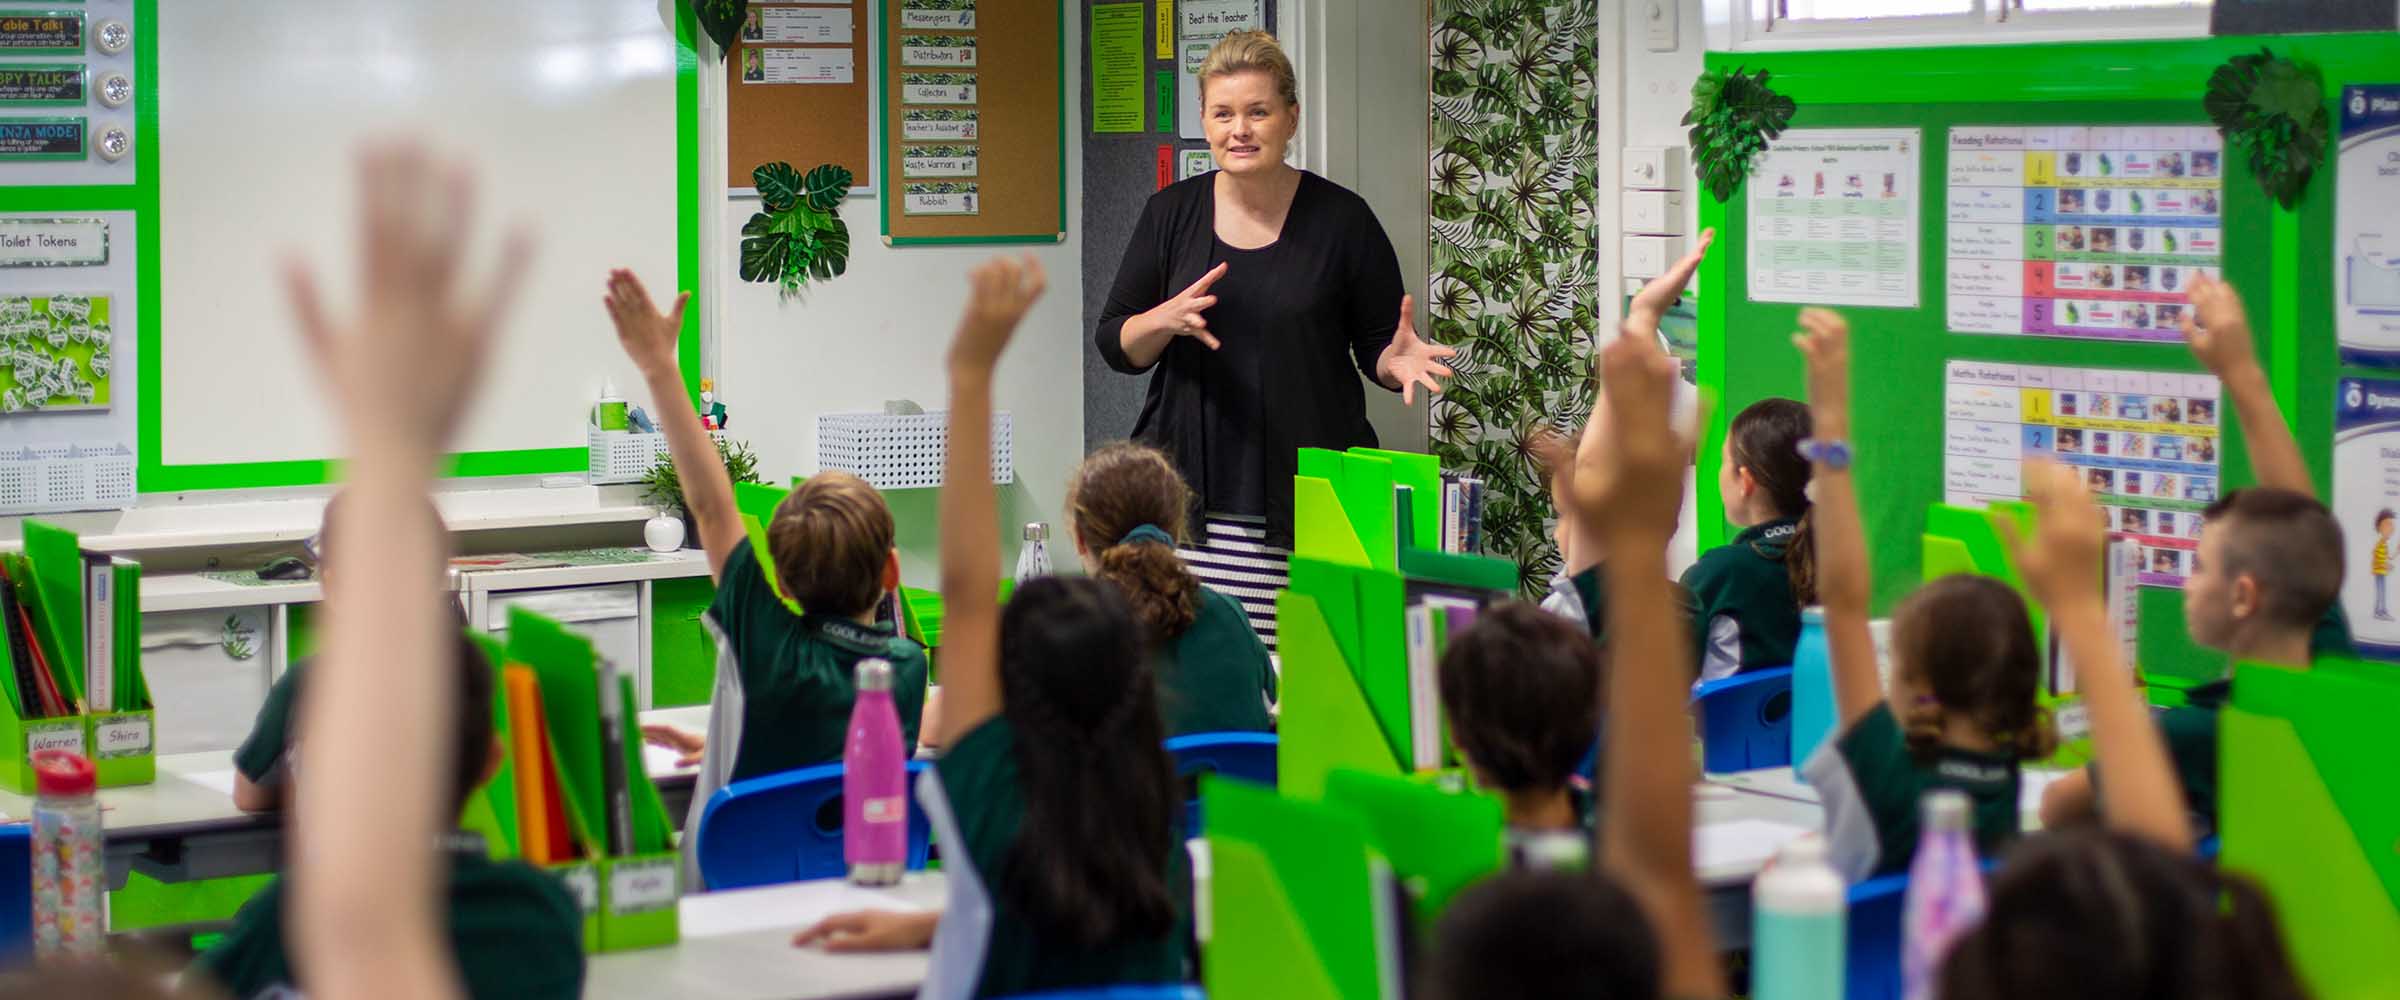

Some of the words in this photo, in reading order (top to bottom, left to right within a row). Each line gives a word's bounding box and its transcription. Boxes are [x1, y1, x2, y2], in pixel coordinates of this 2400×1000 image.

[0, 18, 30, 31] able
[33, 19, 65, 32] Talk!
[907, 11, 951, 26] Messengers
[1189, 13, 1205, 25] Beat
[1207, 11, 1219, 23] the
[1221, 10, 1249, 23] Teacher
[913, 49, 954, 61] Distributors
[27, 72, 66, 86] TALK!
[918, 87, 948, 97] Collectors
[35, 126, 78, 141] MODE!
[1952, 133, 1984, 148] Reading
[905, 160, 925, 170] Waste
[927, 160, 956, 169] Warriors
[919, 195, 948, 206] Rubbish
[2034, 193, 2045, 211] 2
[0, 234, 31, 247] Toilet
[36, 234, 77, 247] Tokens
[2034, 230, 2045, 249] 3
[2034, 267, 2044, 285] 4
[2033, 303, 2044, 321] 5
[2033, 431, 2043, 449] 2
[33, 737, 79, 751] Warren
